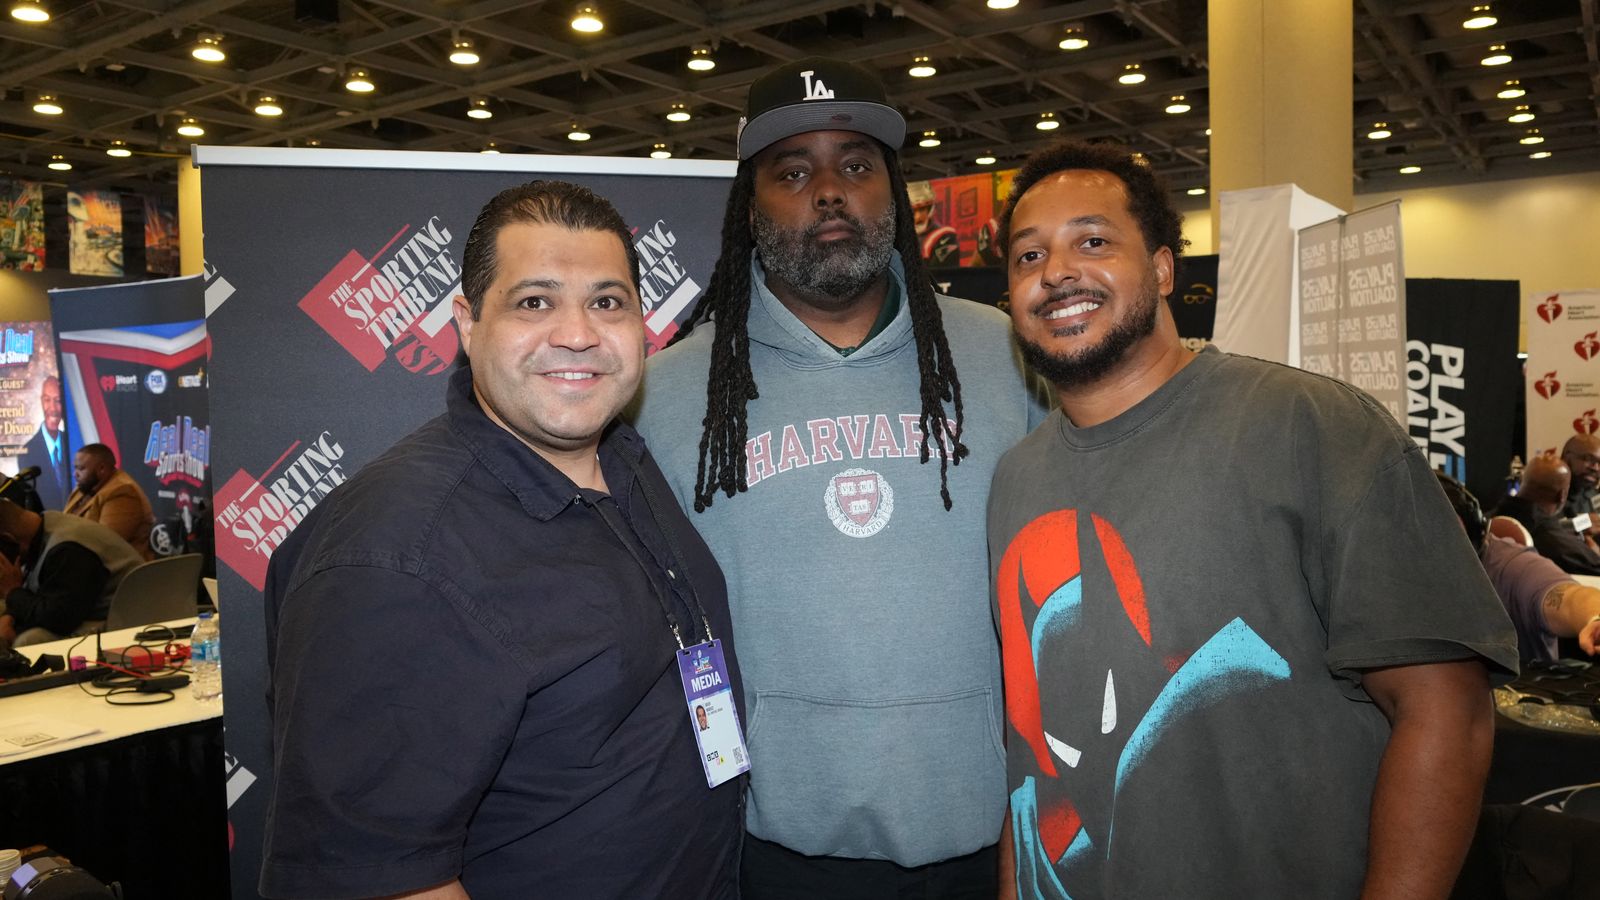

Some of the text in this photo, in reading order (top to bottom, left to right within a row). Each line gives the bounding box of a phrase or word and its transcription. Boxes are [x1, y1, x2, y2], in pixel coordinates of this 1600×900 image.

[800, 70, 835, 101] LA
[344, 215, 452, 331] SPORTING
[640, 250, 687, 317] BUNE
[328, 280, 356, 308] THE
[366, 249, 463, 350] TRIBUNE
[4, 420, 34, 435] Dixon
[231, 430, 345, 550] SPORTING
[216, 500, 244, 529] THE
[842, 520, 883, 535] HARVARD
[691, 671, 722, 692] MEDIA
